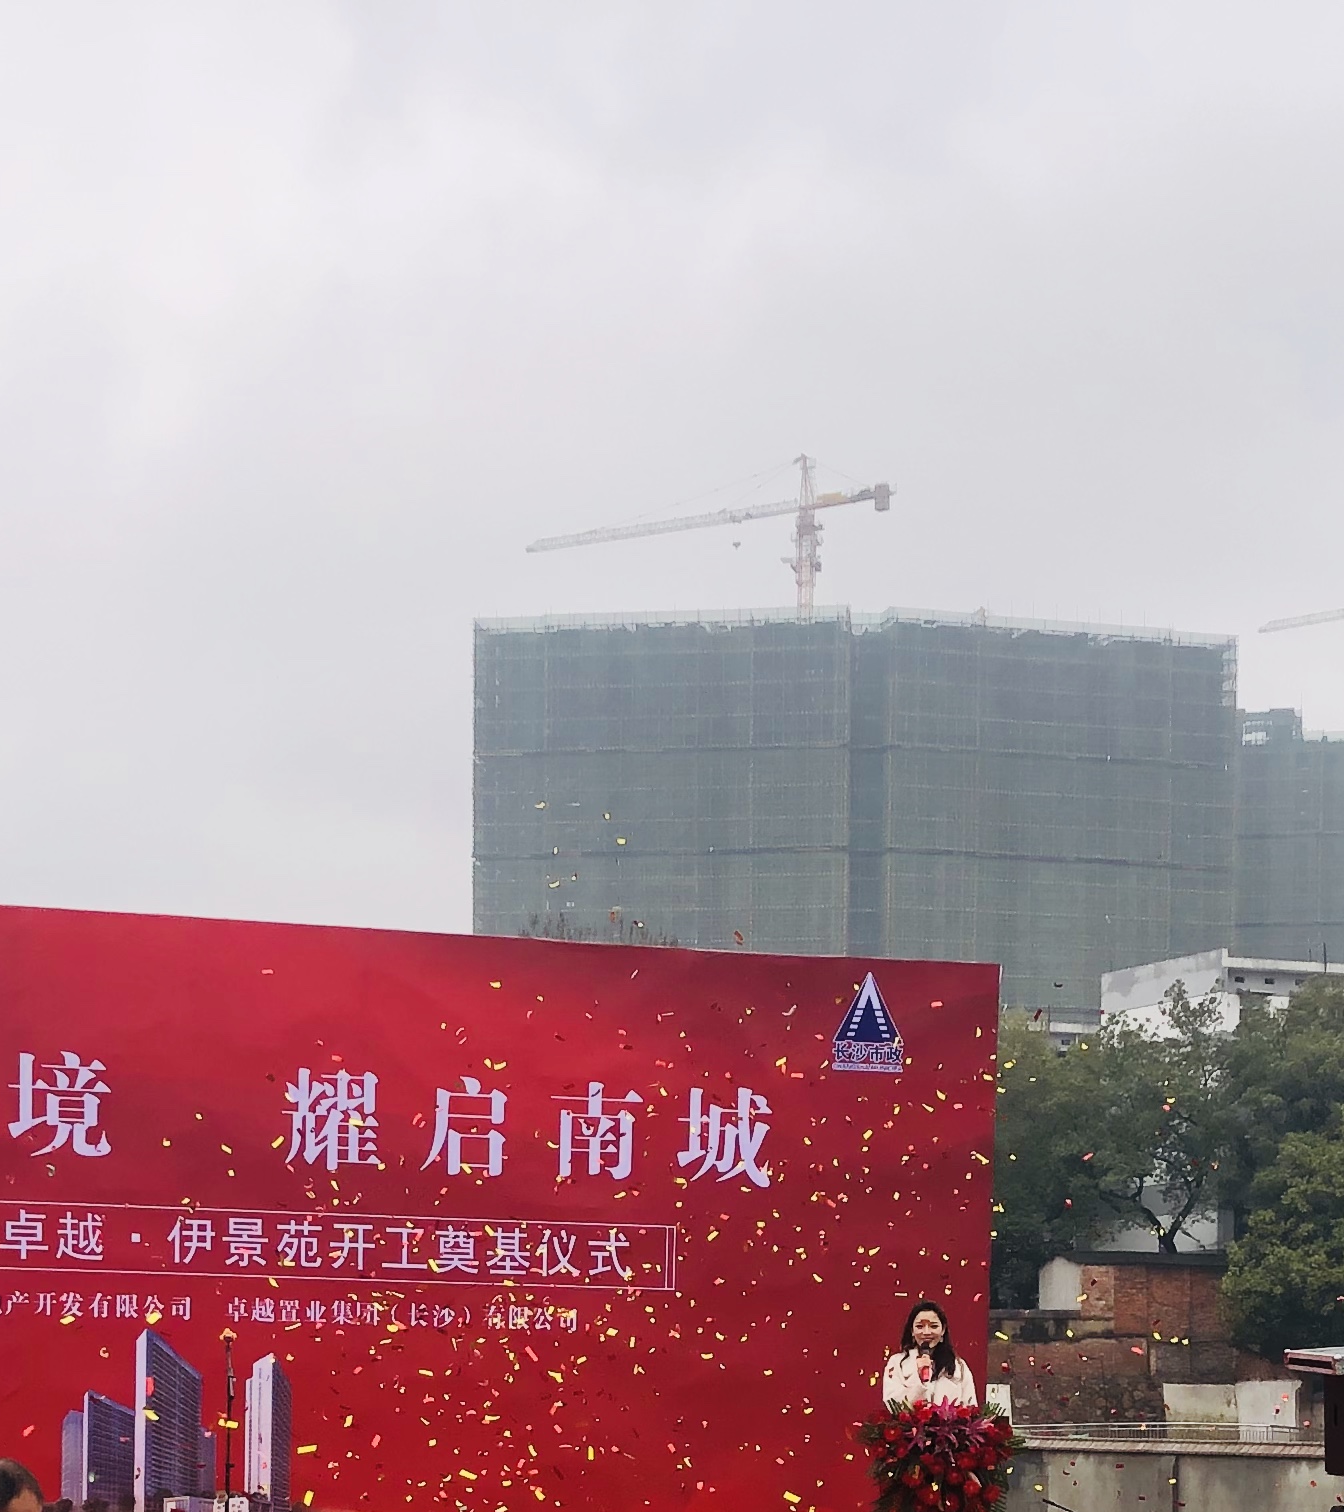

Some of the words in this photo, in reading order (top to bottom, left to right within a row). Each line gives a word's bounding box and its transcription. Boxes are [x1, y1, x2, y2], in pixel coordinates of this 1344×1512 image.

[833, 1041, 904, 1064] 长沙市政
[281, 1066, 774, 1188] 耀启南城
